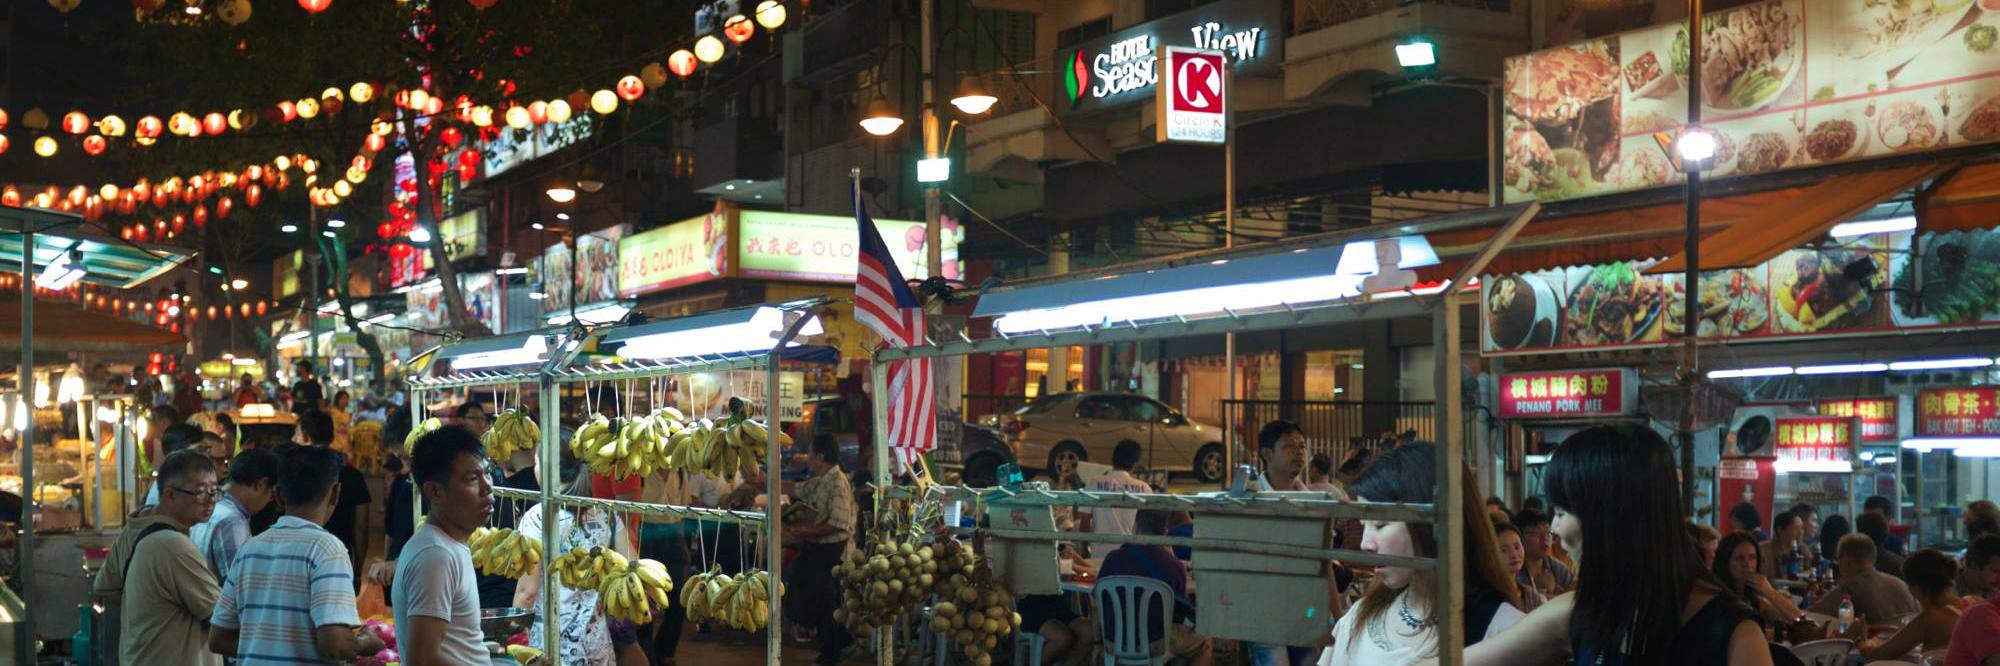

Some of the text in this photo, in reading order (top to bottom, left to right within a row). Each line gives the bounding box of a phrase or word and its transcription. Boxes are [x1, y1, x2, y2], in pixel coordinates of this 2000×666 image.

[1111, 35, 1151, 63] HOTEL
[1094, 23, 1260, 97] Seaso View
[1175, 113, 1222, 128] Circle K
[1174, 127, 1223, 140] 24 HOURS
[812, 241, 854, 257] OLO
[653, 242, 695, 272] OLOIYA
[1516, 399, 1603, 413] PENANG PORK MEE
[1927, 419, 1941, 432] BAK
[1945, 418, 1959, 432] KUT
[1963, 418, 1976, 432] TEH
